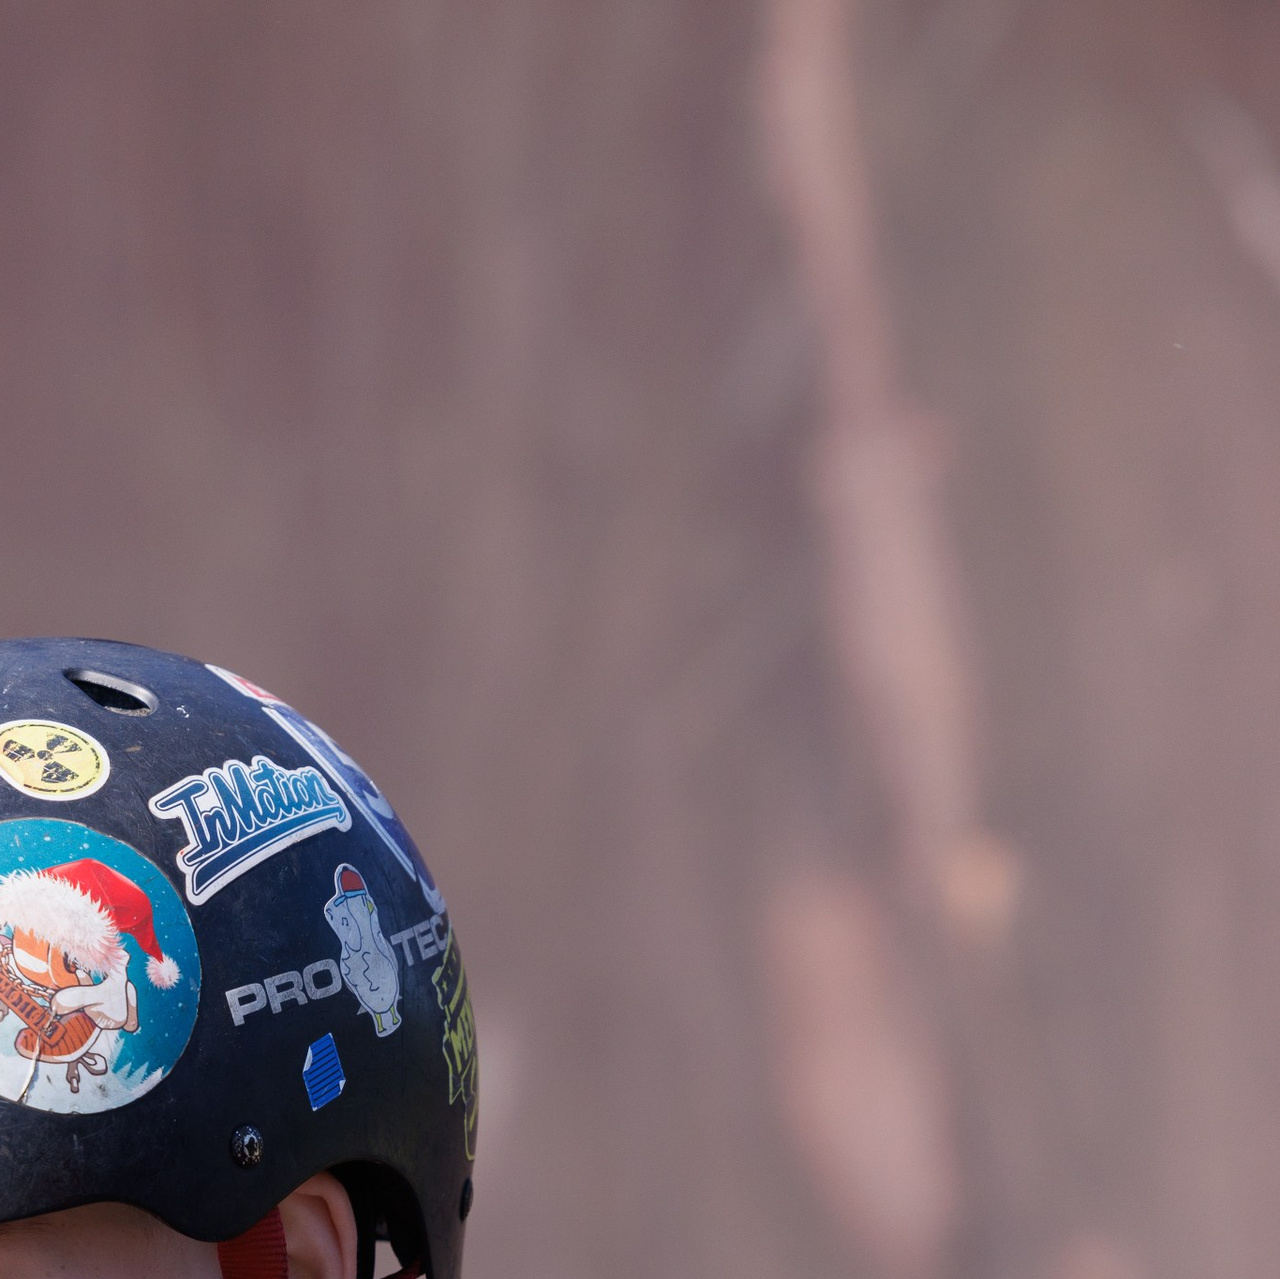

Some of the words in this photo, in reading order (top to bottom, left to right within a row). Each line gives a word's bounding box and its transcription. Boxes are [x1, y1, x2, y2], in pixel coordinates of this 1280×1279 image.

[155, 759, 340, 867] InMotion
[225, 957, 343, 1027] PRO
[389, 913, 451, 967] TEC
